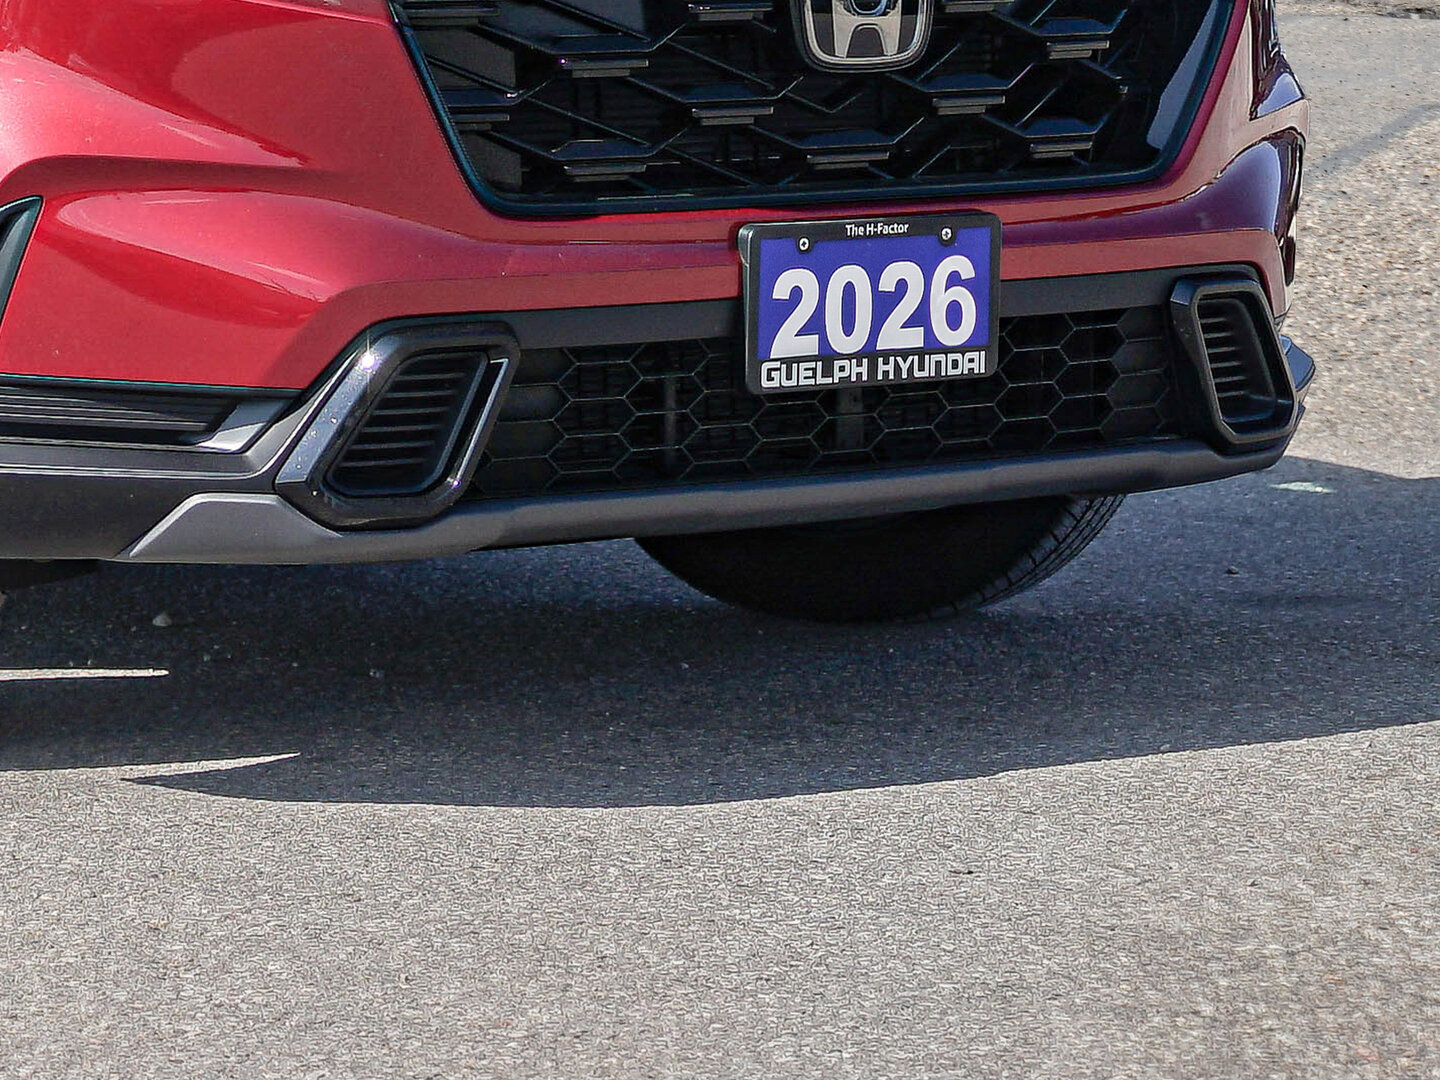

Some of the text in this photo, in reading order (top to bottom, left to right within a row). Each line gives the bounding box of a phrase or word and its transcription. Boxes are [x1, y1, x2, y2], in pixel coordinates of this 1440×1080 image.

[845, 222, 909, 237] The H-Factor
[770, 255, 977, 359] 2026
[761, 351, 986, 388] GUELPH HYUNDAI
